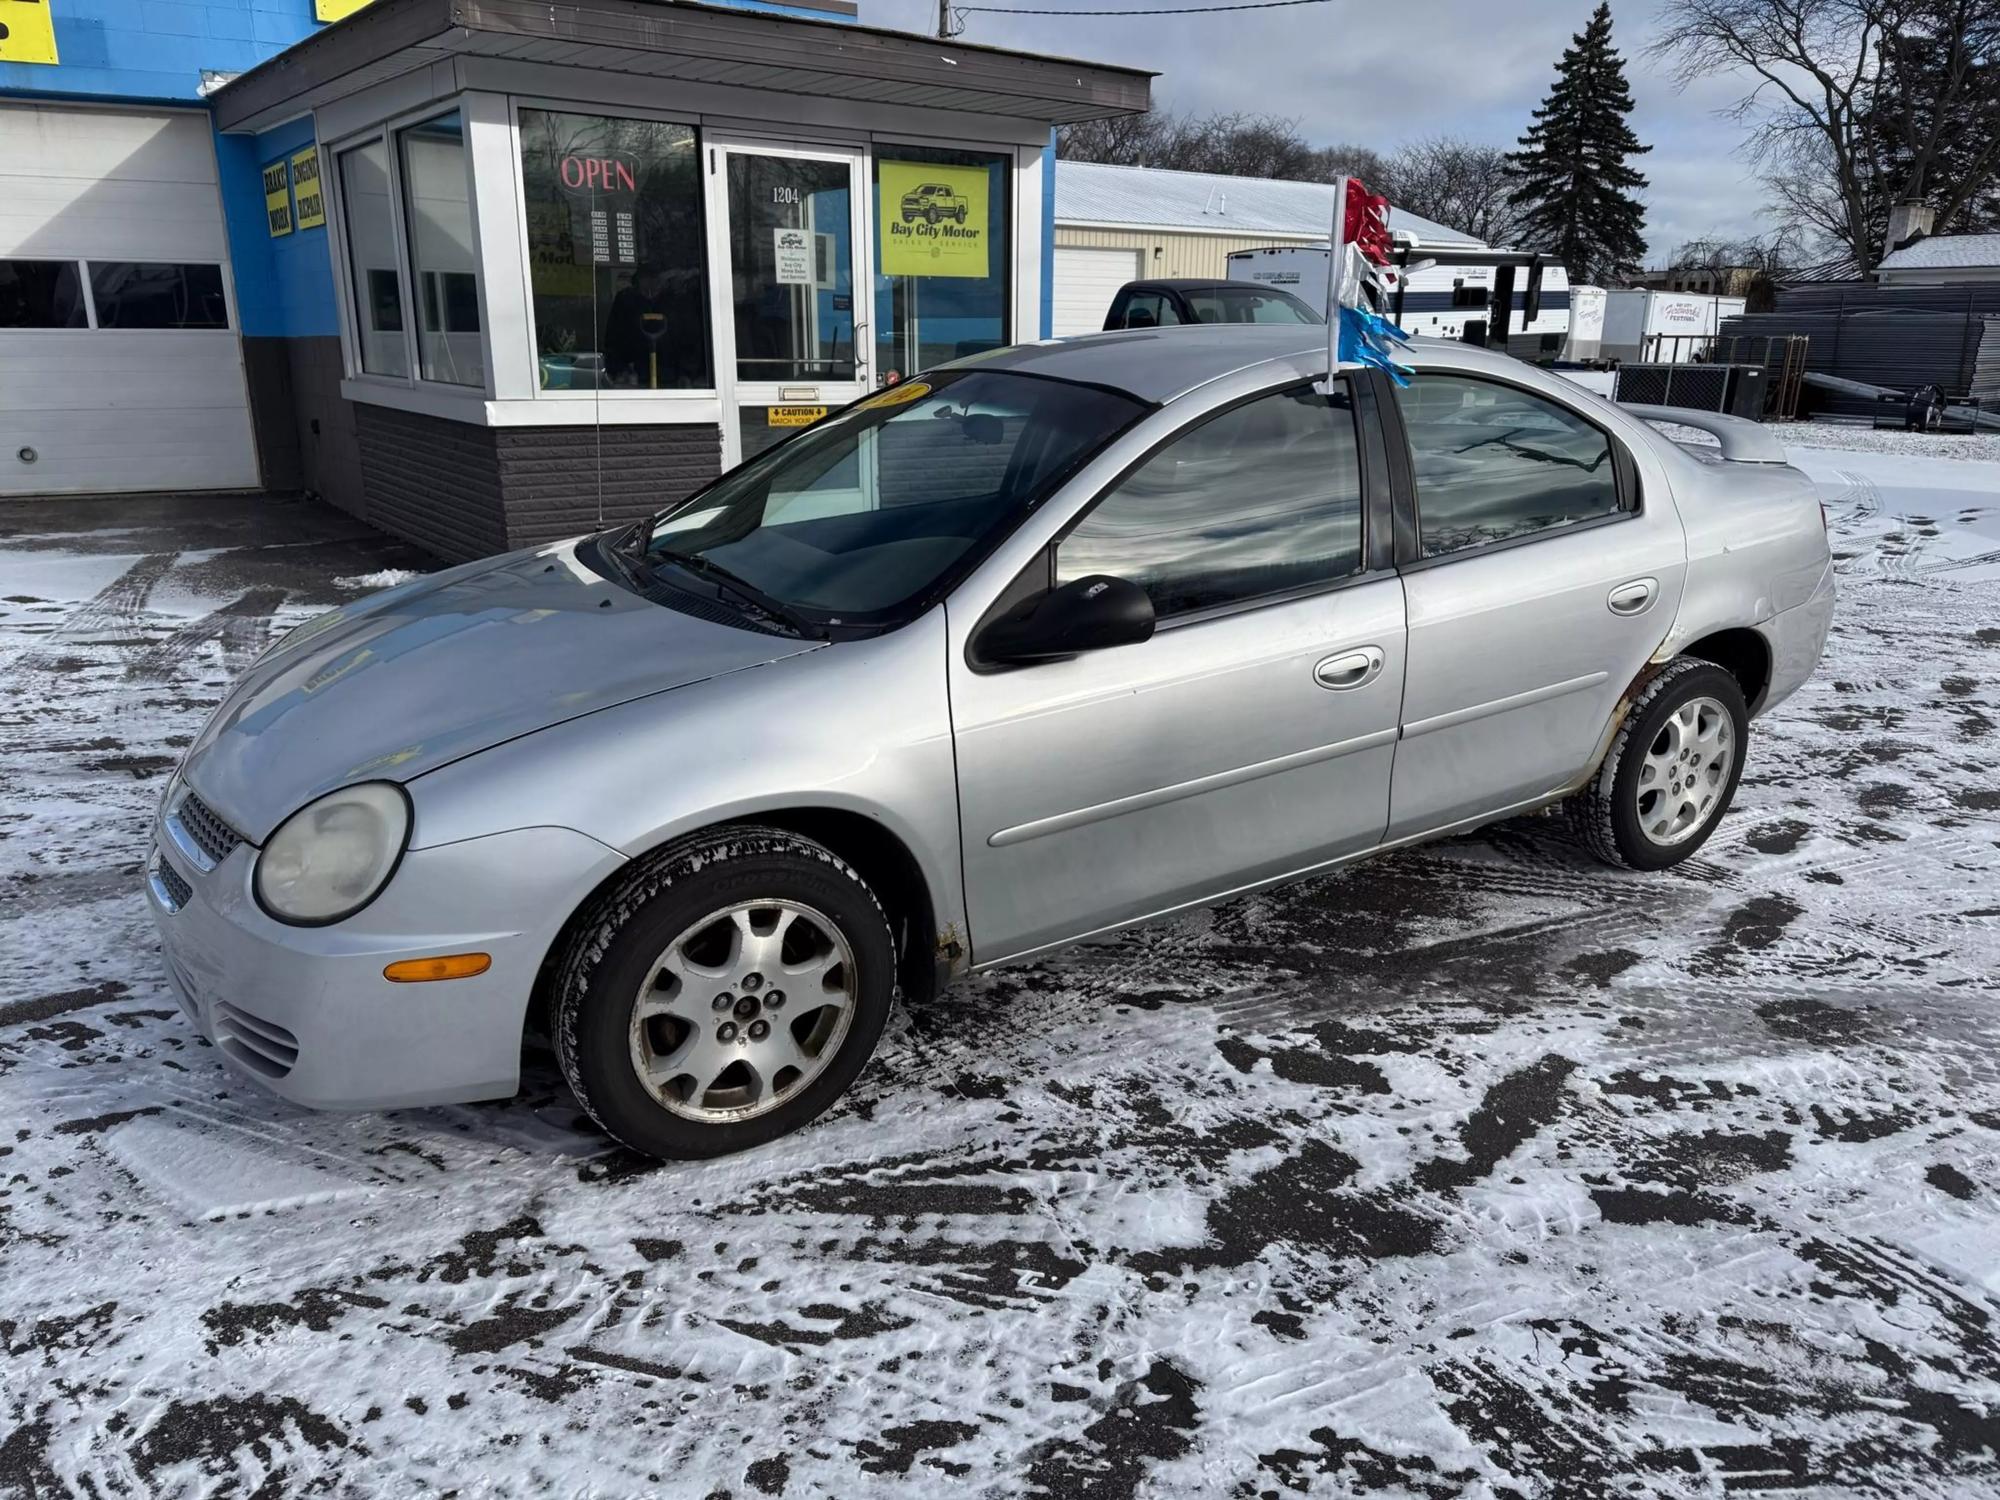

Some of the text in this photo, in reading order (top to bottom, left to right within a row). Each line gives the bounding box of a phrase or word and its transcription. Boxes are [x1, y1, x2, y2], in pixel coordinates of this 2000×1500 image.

[264, 165, 287, 195] BRAKE
[292, 156, 317, 185] ENGINE
[560, 155, 636, 192] OPEN
[297, 193, 322, 220] REPAIR
[773, 187, 799, 204] 1204
[269, 205, 290, 232] WORK
[891, 221, 980, 239] Bay City Motor
[781, 408, 815, 417] CAUTION
